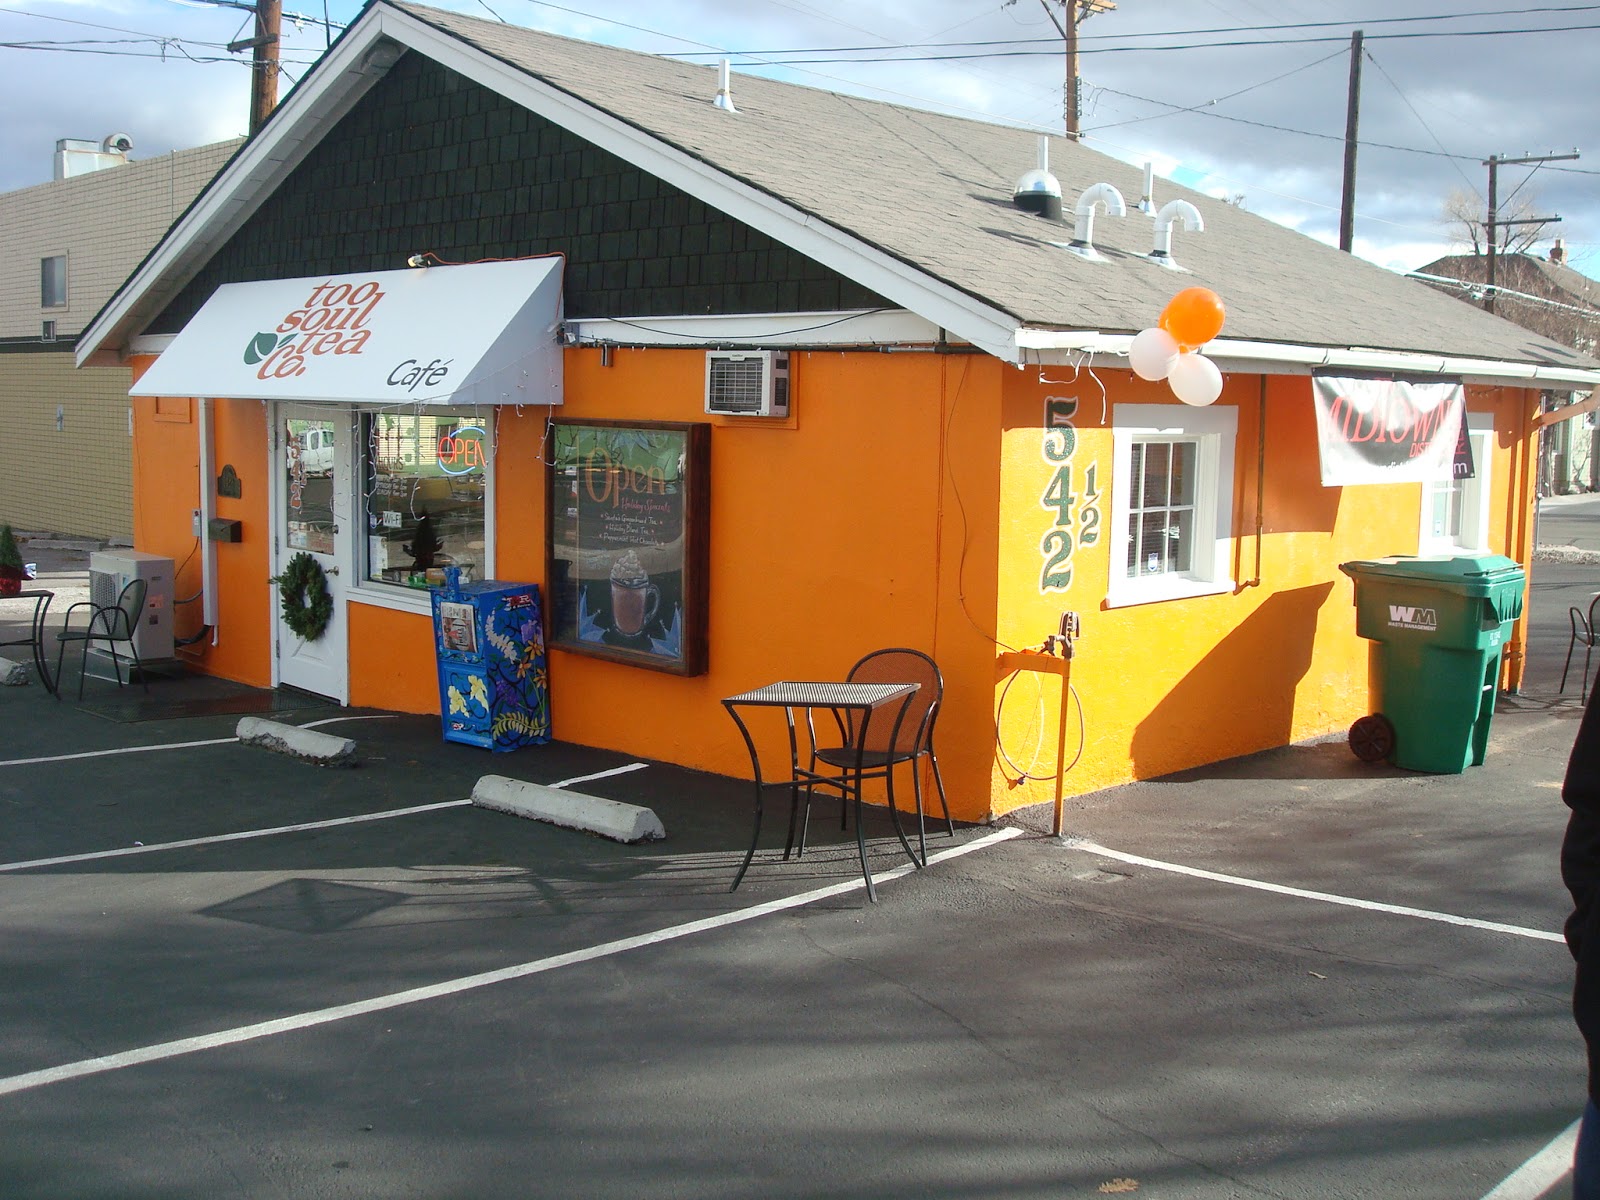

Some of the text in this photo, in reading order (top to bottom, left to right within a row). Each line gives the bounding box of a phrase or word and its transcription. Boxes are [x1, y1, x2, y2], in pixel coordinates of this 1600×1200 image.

[305, 279, 380, 308] too
[276, 292, 386, 333] soul
[296, 324, 371, 355] tea
[257, 344, 306, 380] Co.
[387, 358, 454, 392] Café
[438, 436, 486, 468] OPEN
[585, 447, 666, 508] Open
[1042, 397, 1078, 591] 542
[1389, 605, 1437, 625] WM
[1404, 623, 1437, 631] MANAGEMENT
